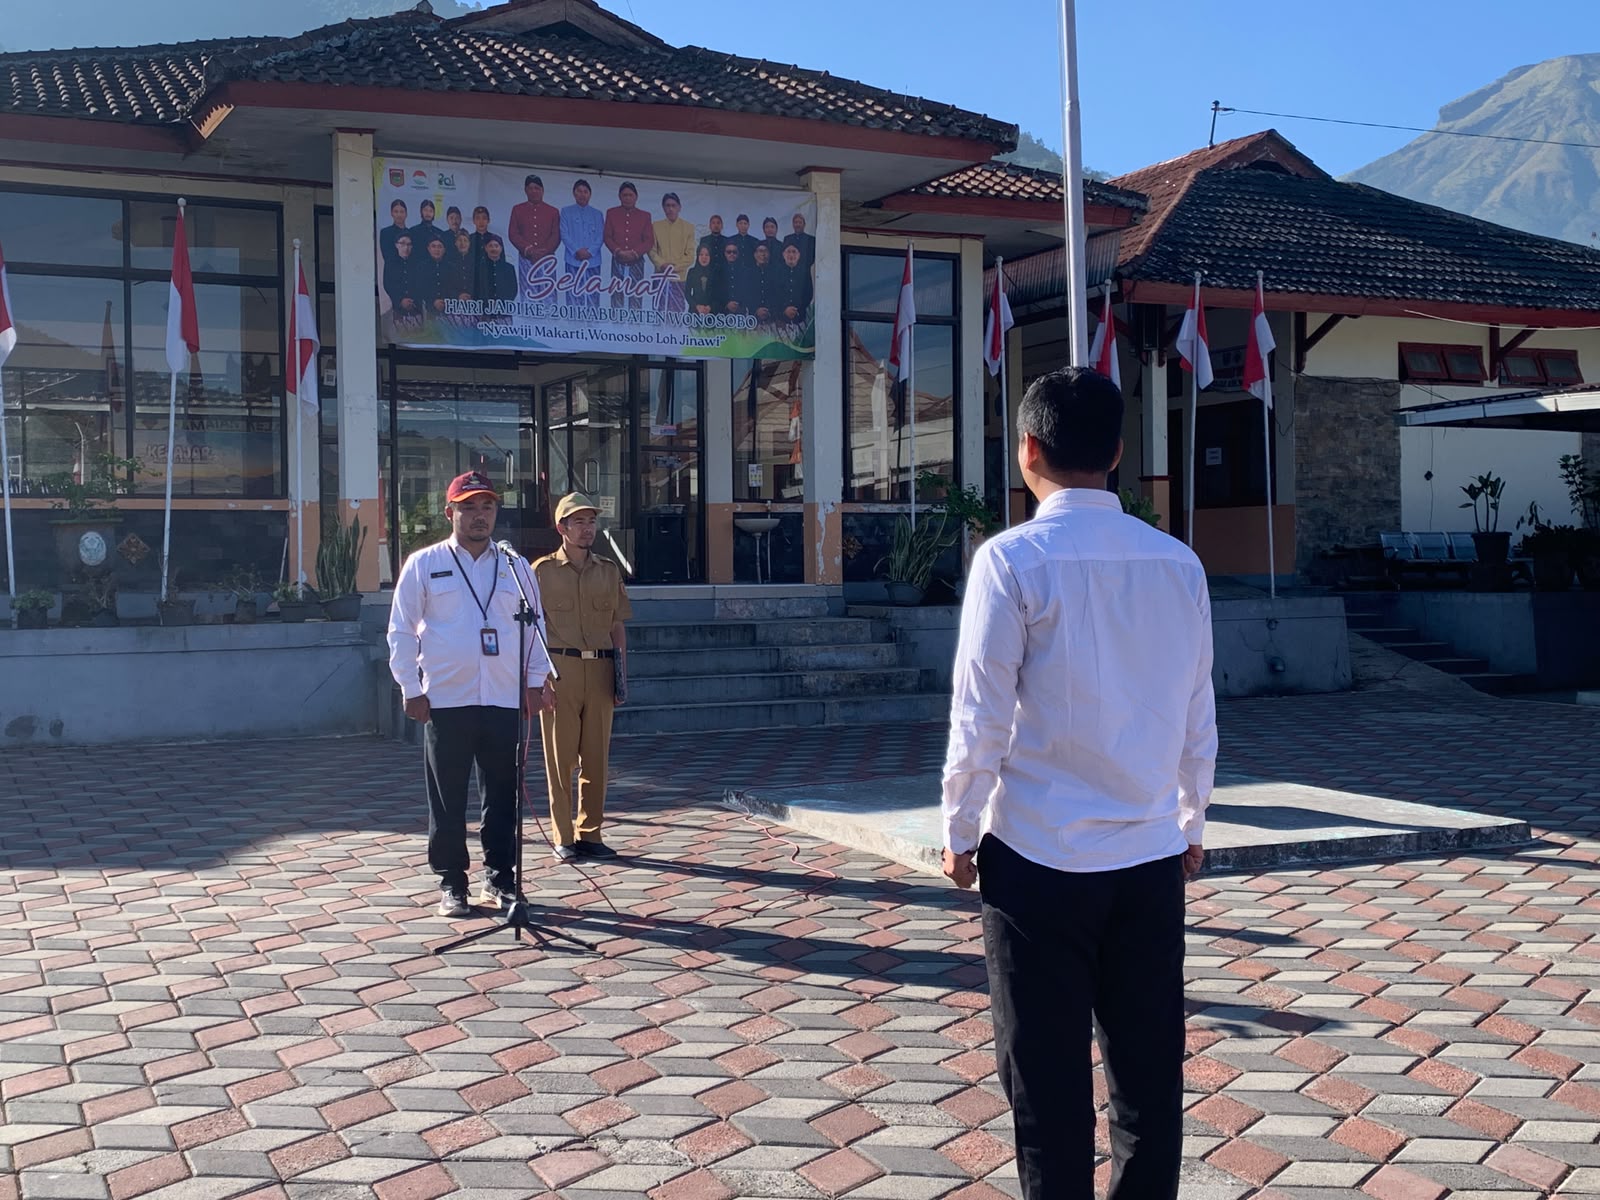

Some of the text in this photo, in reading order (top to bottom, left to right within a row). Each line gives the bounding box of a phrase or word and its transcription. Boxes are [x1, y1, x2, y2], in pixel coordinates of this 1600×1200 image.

[527, 255, 678, 308] Selamat
[445, 299, 757, 330] HARI JADI KE-201 KABUPATEN WONOSOBO
[656, 332, 678, 345] Loh
